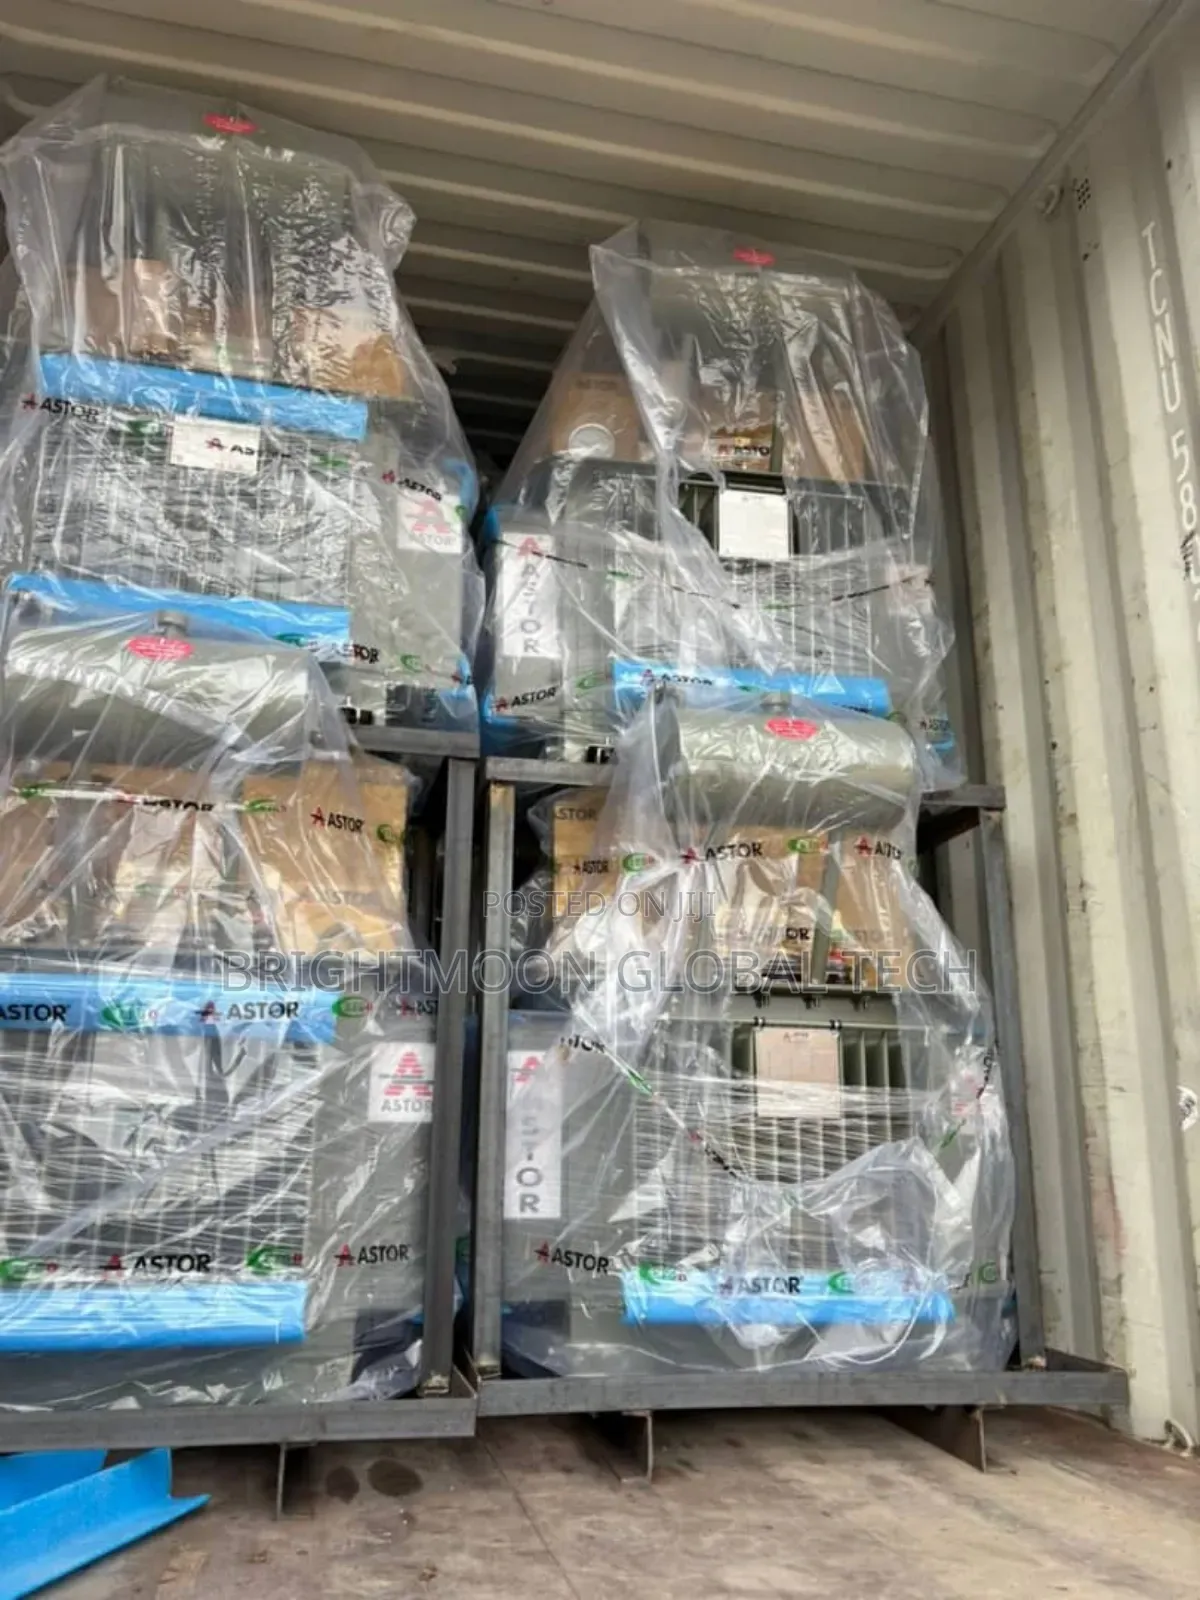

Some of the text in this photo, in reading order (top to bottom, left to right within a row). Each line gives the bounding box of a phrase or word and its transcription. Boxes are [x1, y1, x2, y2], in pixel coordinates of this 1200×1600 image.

[1141, 221, 1181, 413] TCNU
[40, 397, 100, 422] ASTOR
[511, 686, 557, 708] ASTOR
[328, 811, 364, 833] ASTOR
[705, 842, 763, 861] ASTOR
[227, 1001, 299, 1021] ASTOR
[134, 1254, 212, 1274] ASTOR
[357, 1244, 409, 1265] ASTOR
[552, 1247, 610, 1274] ASTOR
[737, 1275, 801, 1296] ASTOR
